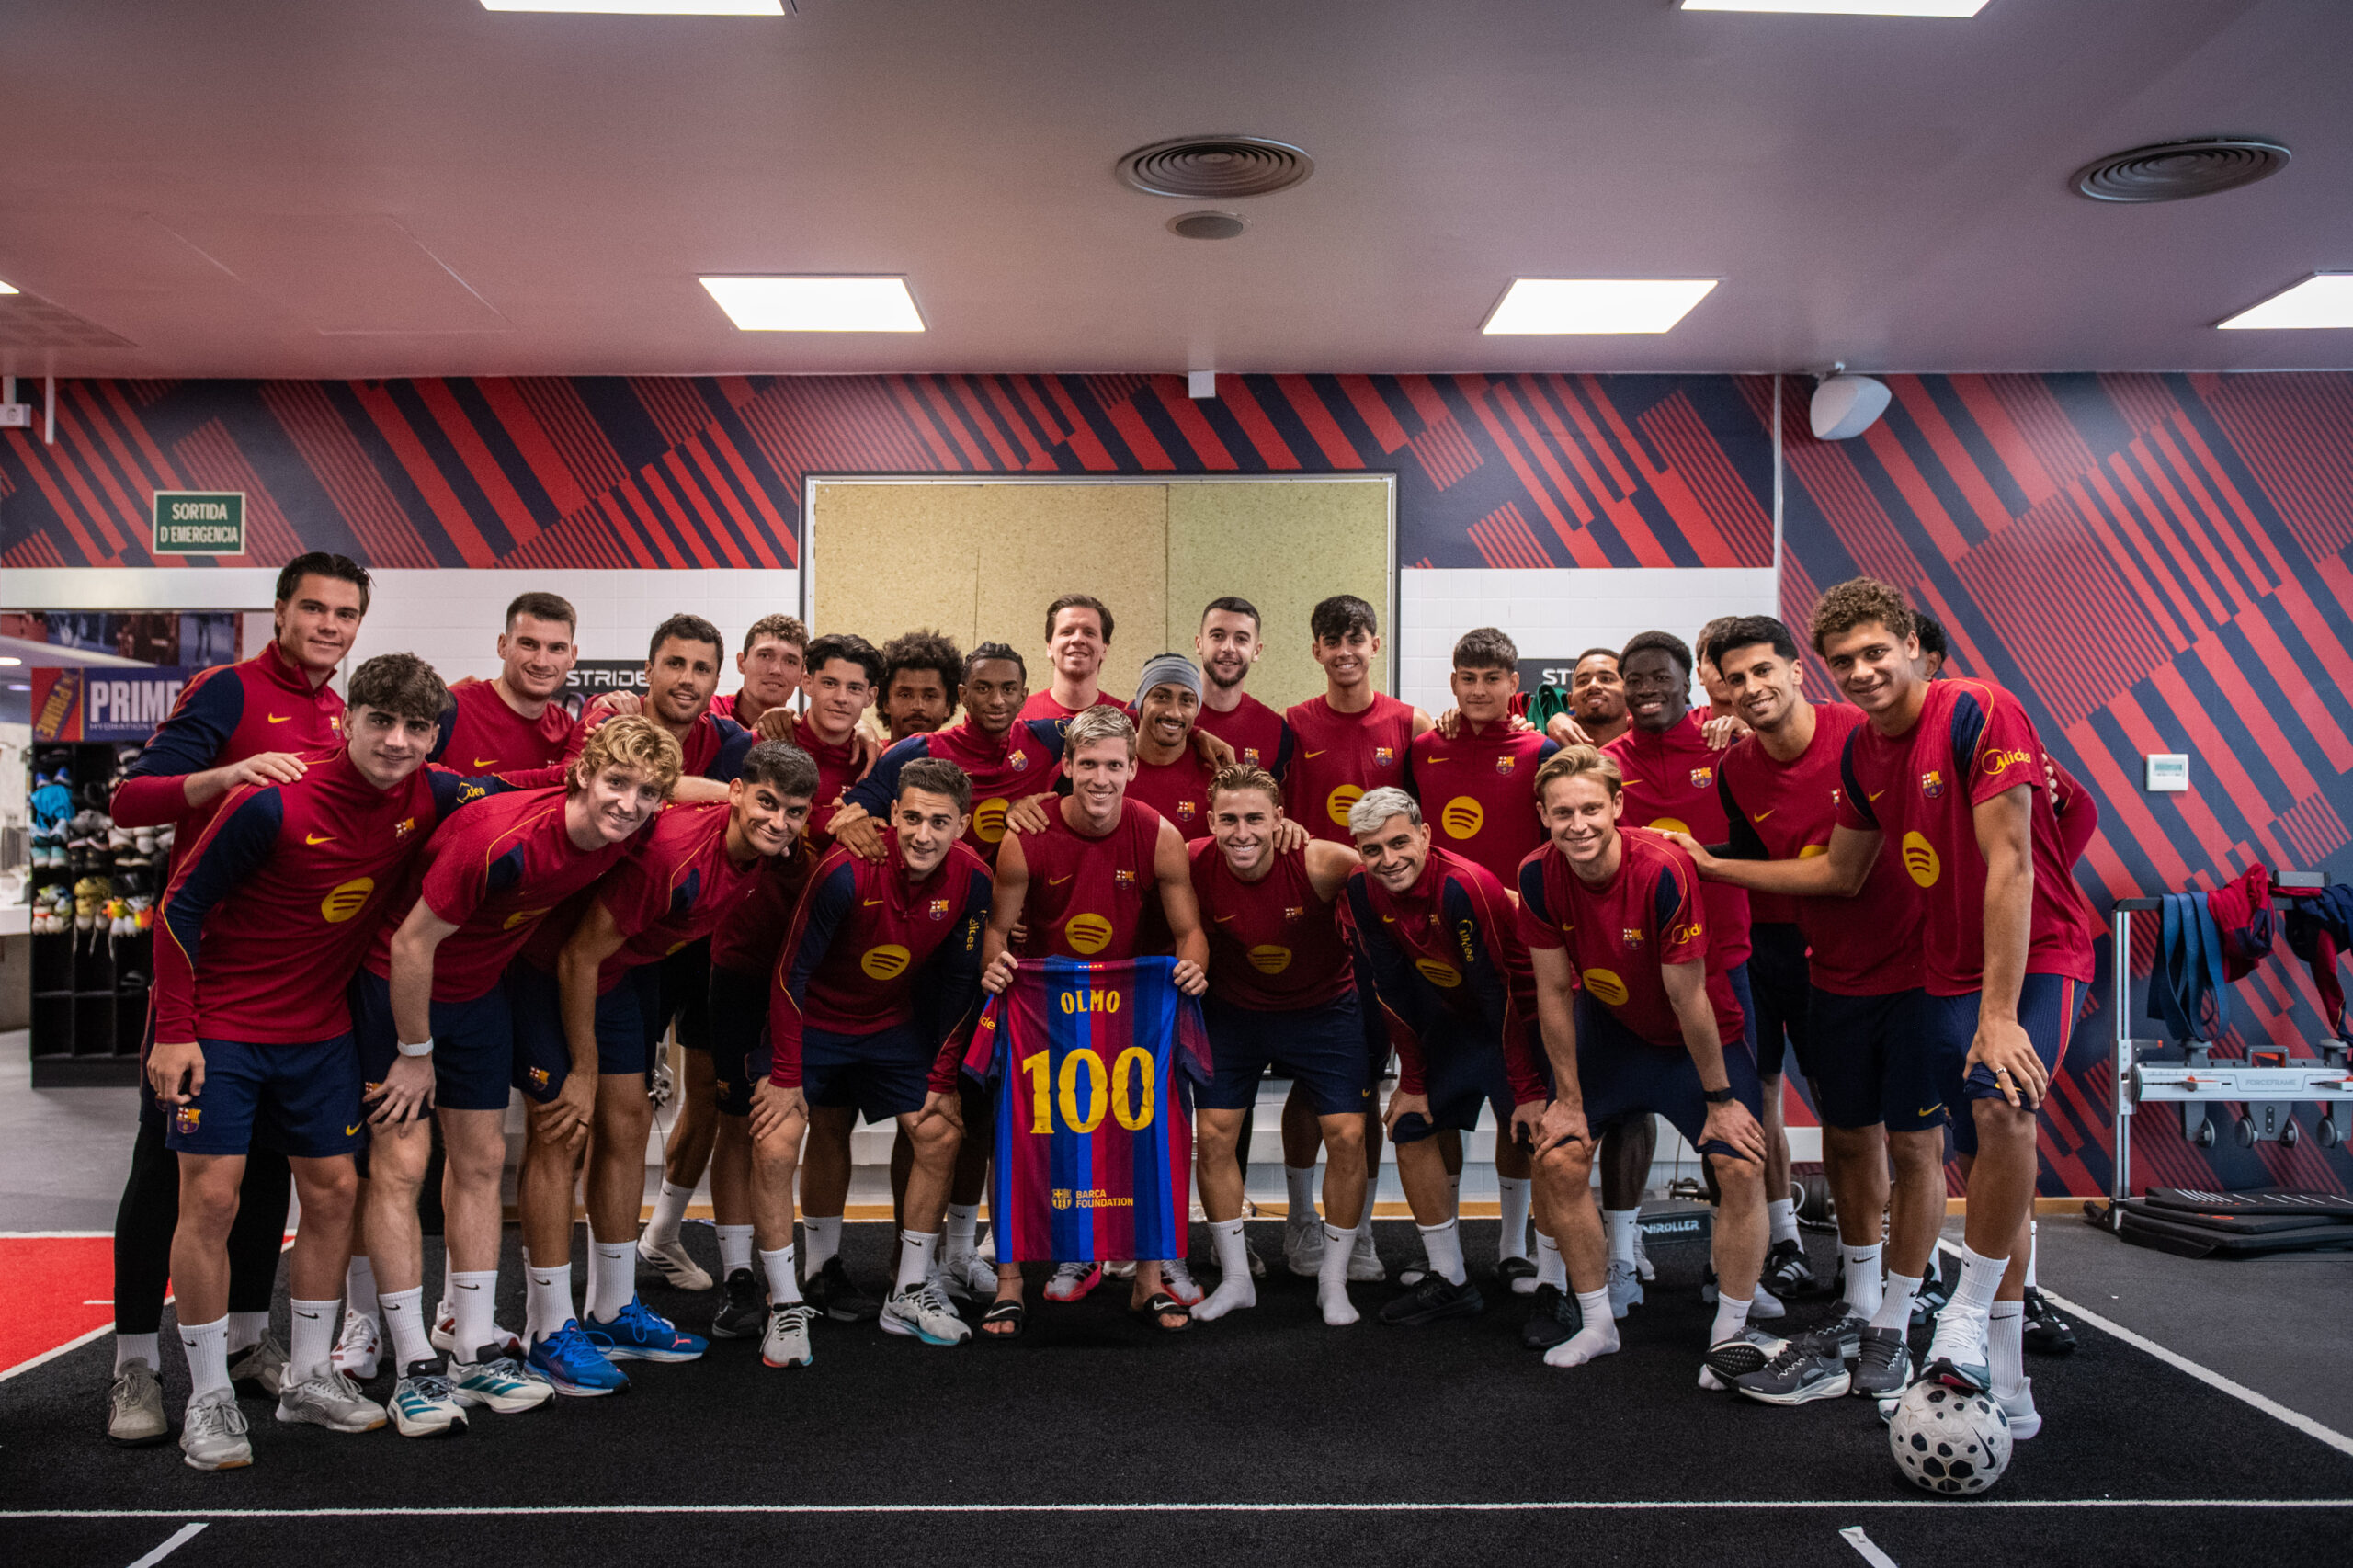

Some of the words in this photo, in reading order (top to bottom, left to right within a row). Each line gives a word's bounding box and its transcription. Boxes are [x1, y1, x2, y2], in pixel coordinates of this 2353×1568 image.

[172, 503, 228, 521] SORTIDA
[565, 669, 651, 687] STRIDE
[1060, 989, 1120, 1015] OLMO
[1022, 1046, 1155, 1134] 100
[1075, 1189, 1107, 1199] BARÇA
[1075, 1198, 1134, 1209] FOUNDATION
